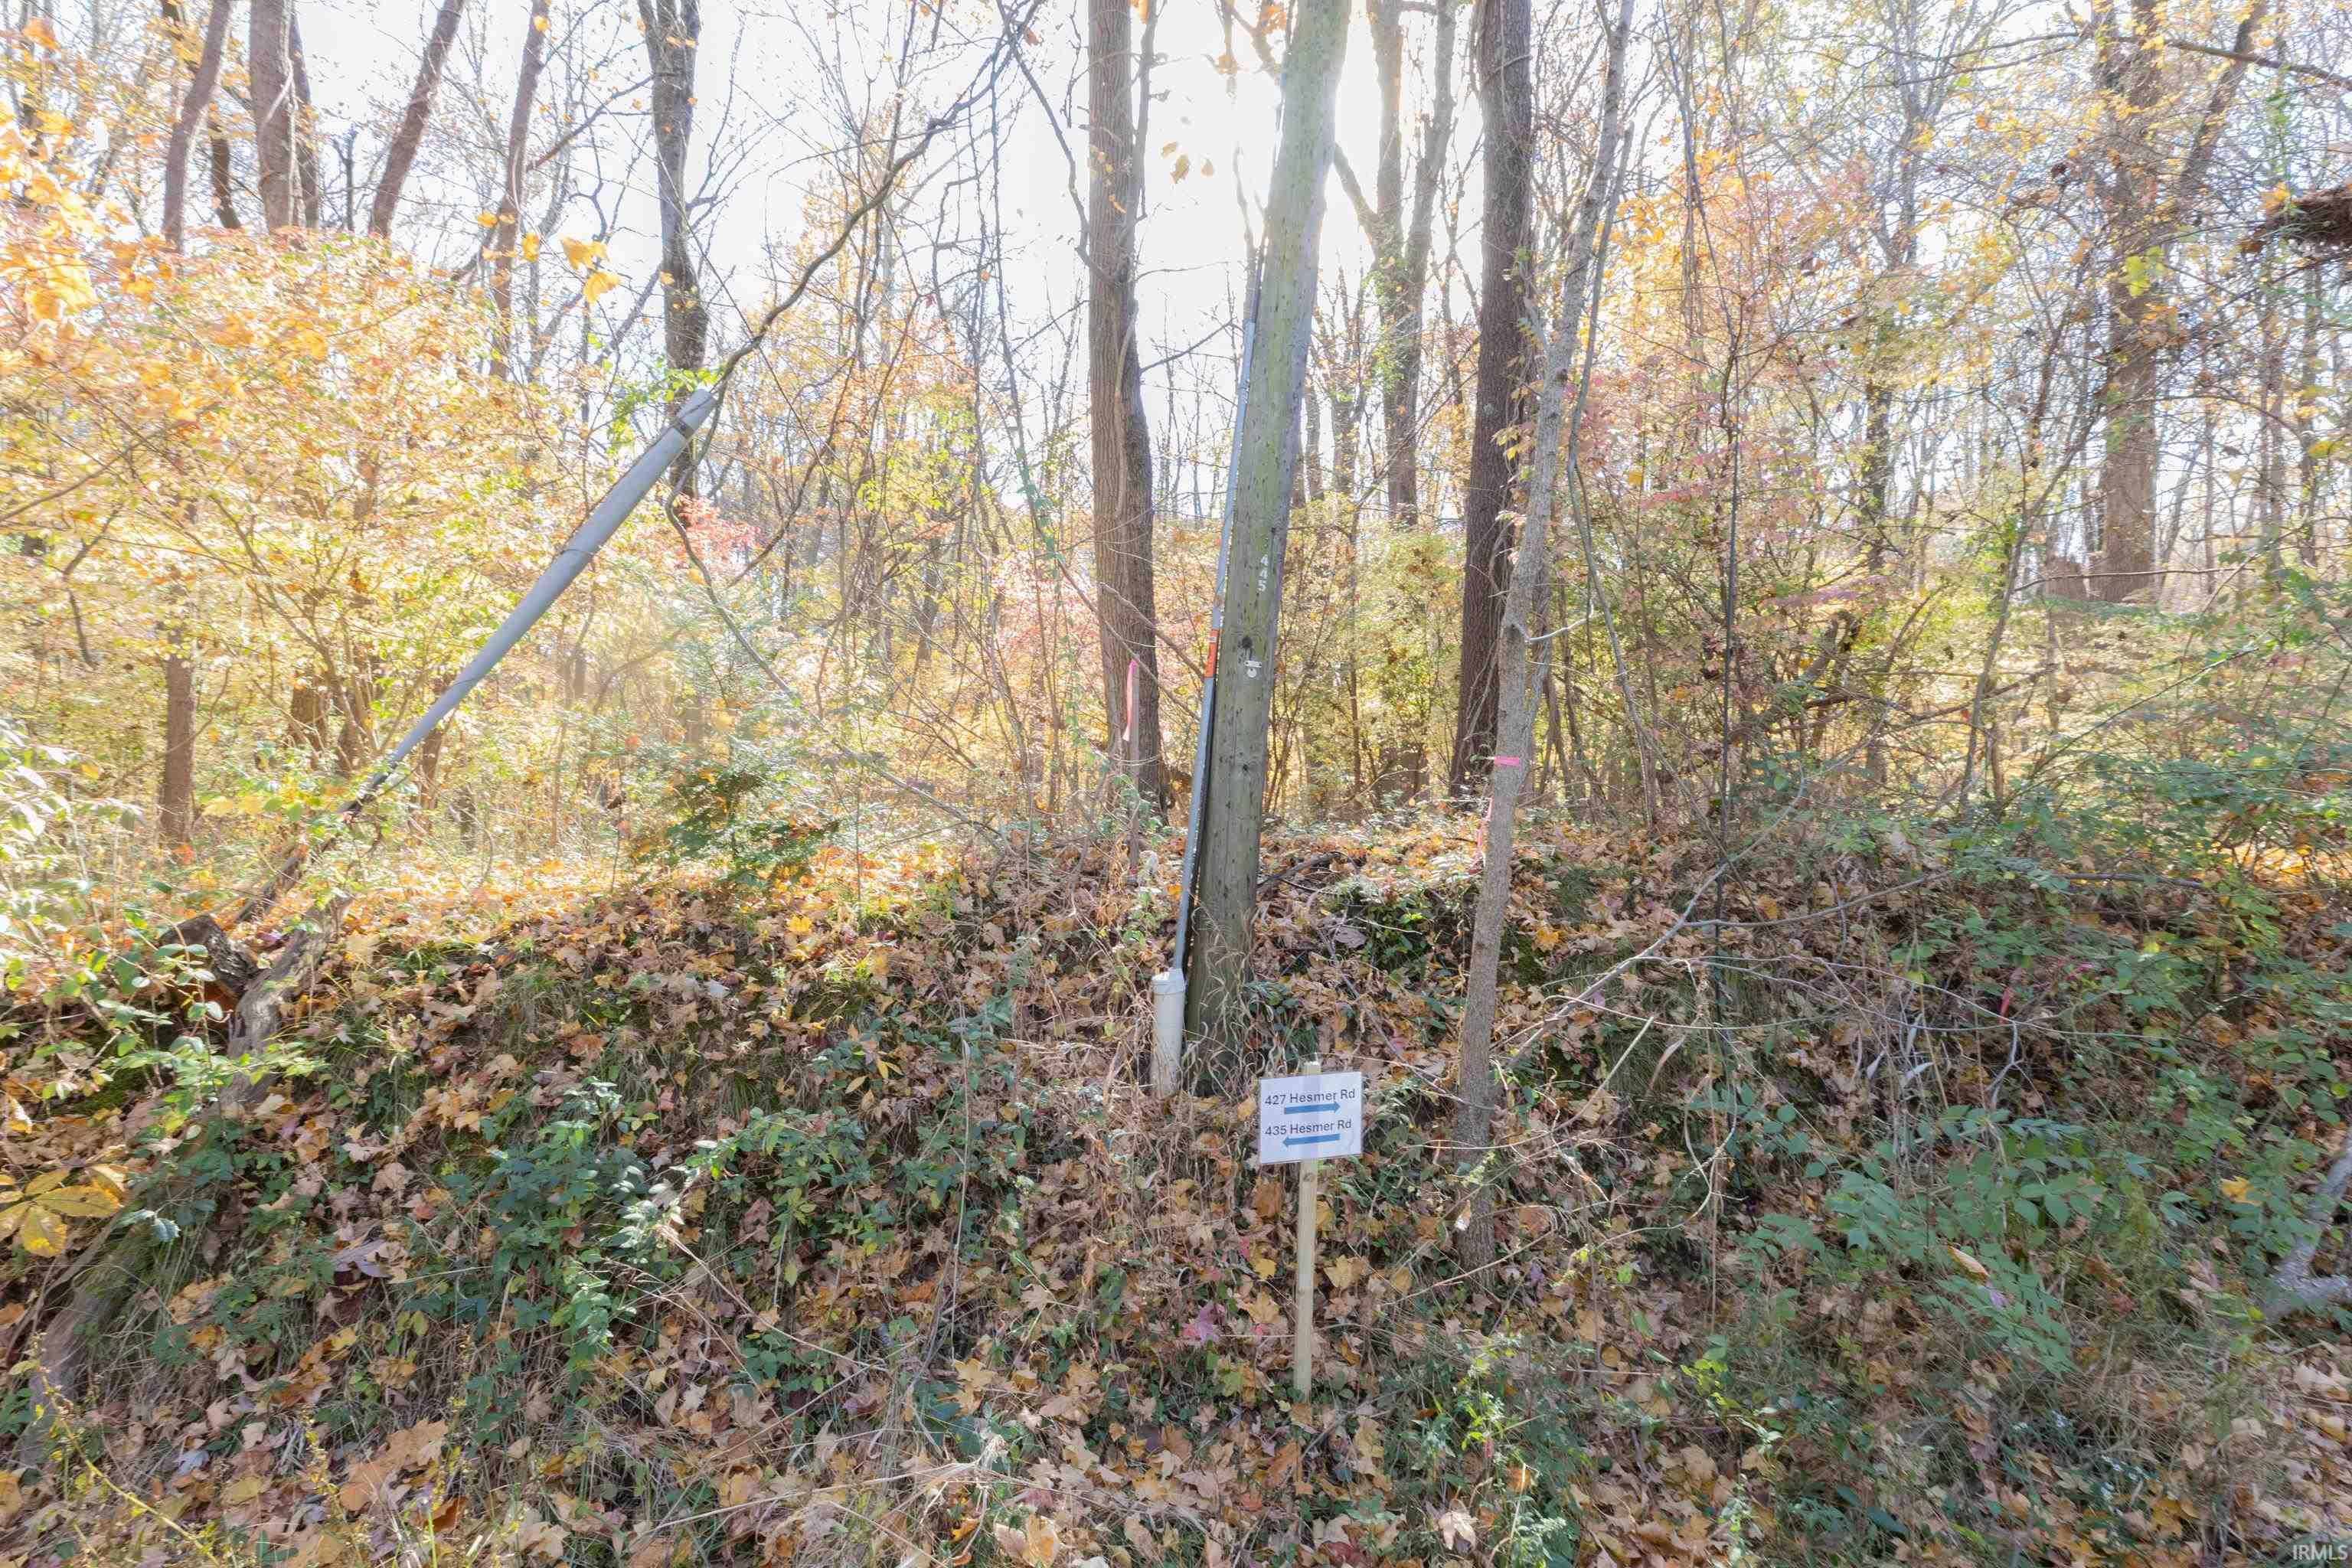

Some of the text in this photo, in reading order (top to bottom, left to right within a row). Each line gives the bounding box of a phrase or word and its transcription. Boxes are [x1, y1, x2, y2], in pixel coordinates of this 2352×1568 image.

[1256, 554, 1269, 592] 445
[1265, 1089, 1355, 1106] 427 Hesmer Rd
[1265, 1119, 1351, 1136] 435 Hesmer Rd
